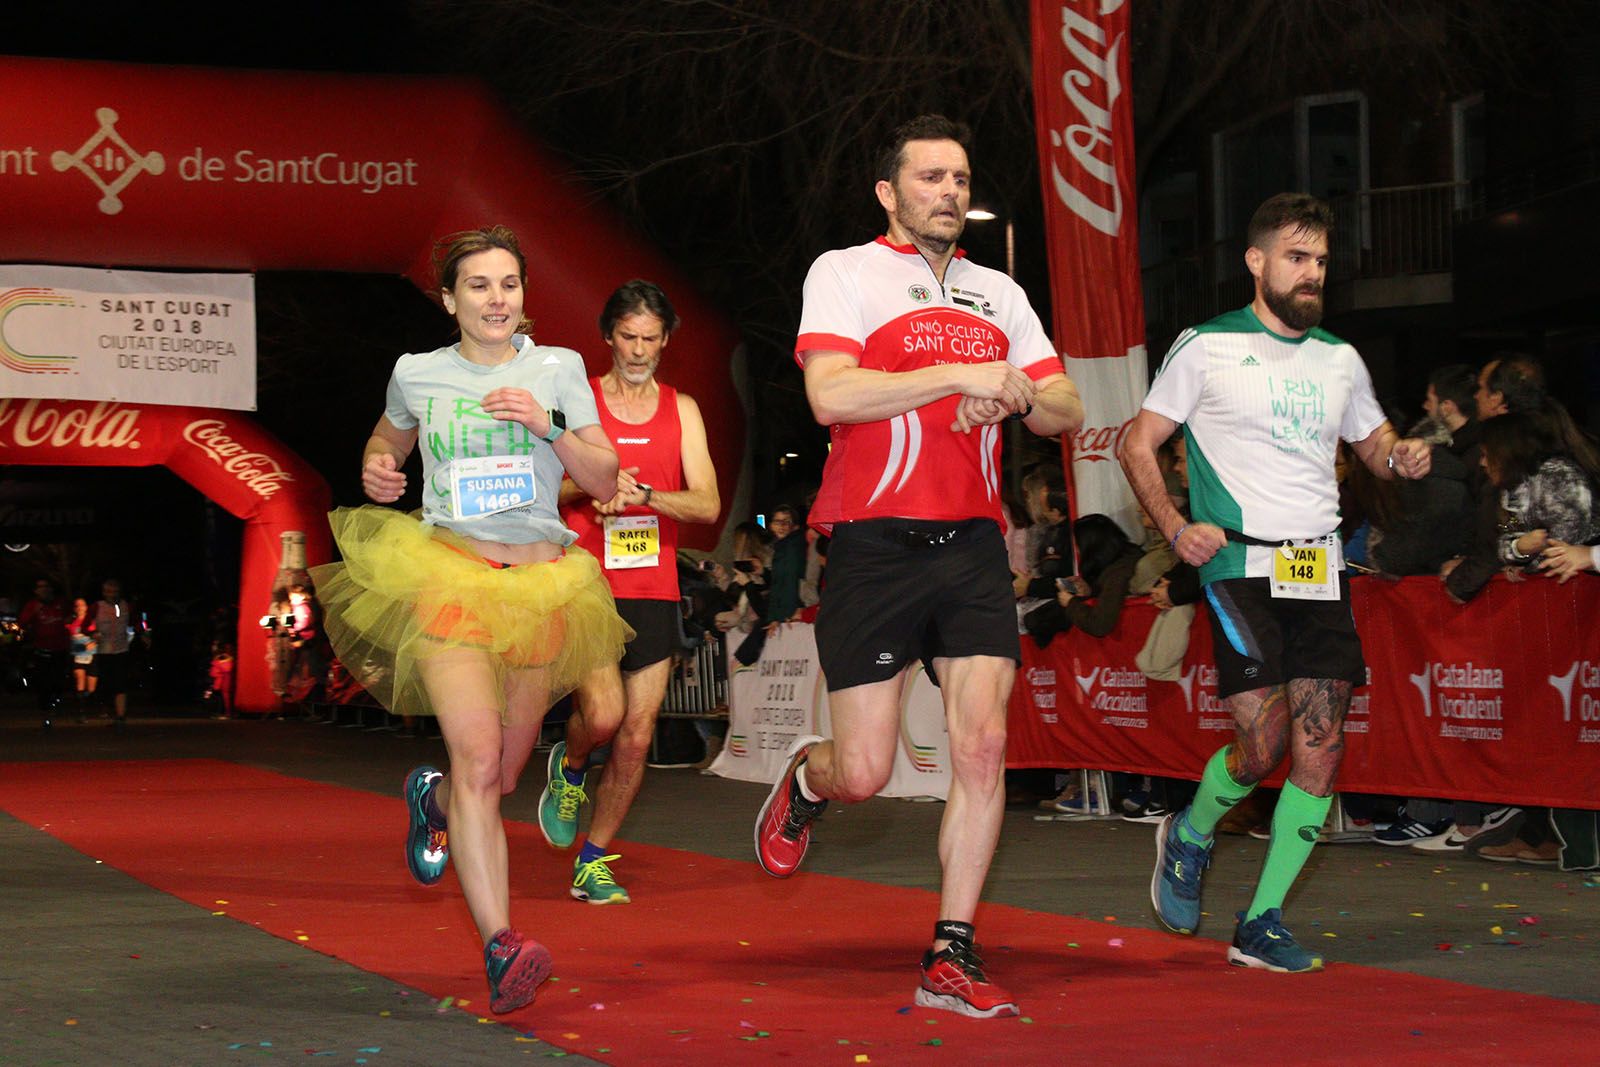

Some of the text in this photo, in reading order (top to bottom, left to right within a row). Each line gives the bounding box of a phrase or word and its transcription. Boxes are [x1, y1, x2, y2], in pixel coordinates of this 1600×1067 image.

[178, 147, 418, 194] de SantCugat
[100, 299, 232, 317] SANT CUGAT
[910, 319, 995, 343] UNIÓ CICLISTA
[98, 334, 237, 356] CIUTAT EUROPEA
[903, 335, 1001, 361] SANT CUGAT
[117, 353, 221, 374] DE L'ESPORT
[1282, 378, 1325, 402] RUN
[1271, 395, 1326, 425] WITH
[427, 420, 536, 463] WITH
[466, 476, 526, 492] SUSANA
[618, 530, 650, 540] RAFEL
[625, 542, 647, 552] 168
[1289, 564, 1314, 579] 148
[1433, 661, 1504, 689] Catalana
